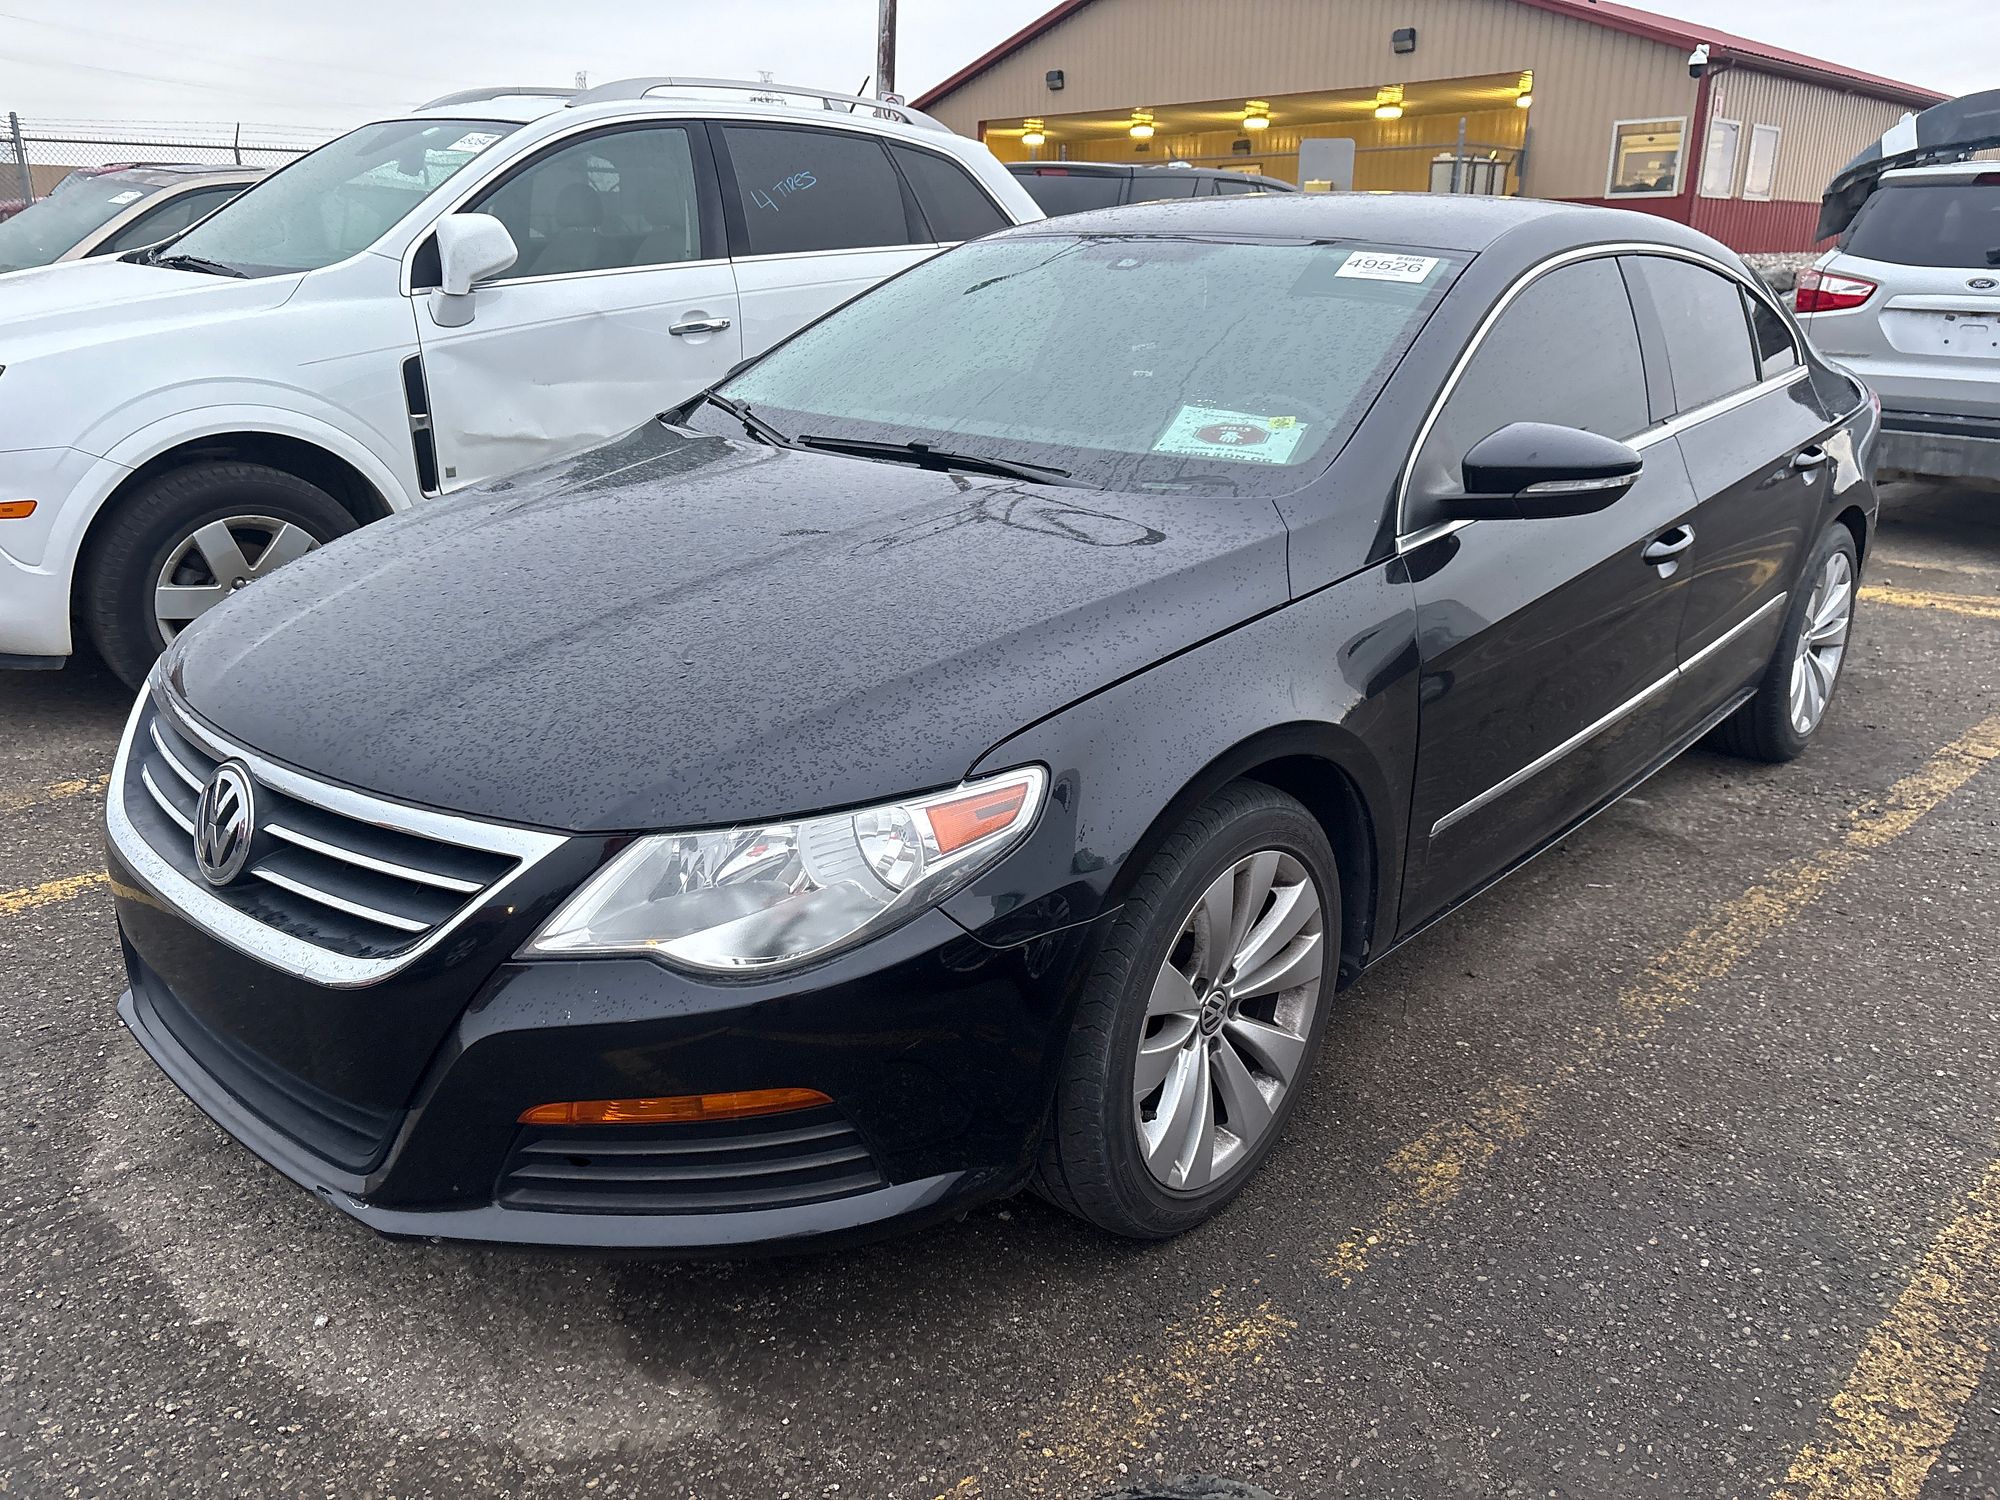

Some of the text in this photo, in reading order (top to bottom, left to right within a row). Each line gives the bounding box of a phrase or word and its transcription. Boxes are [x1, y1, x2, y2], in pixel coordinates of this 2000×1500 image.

[750, 171, 817, 212] 4 TIRES
[1346, 258, 1424, 273] 49526
[1217, 425, 1253, 433] STOP
